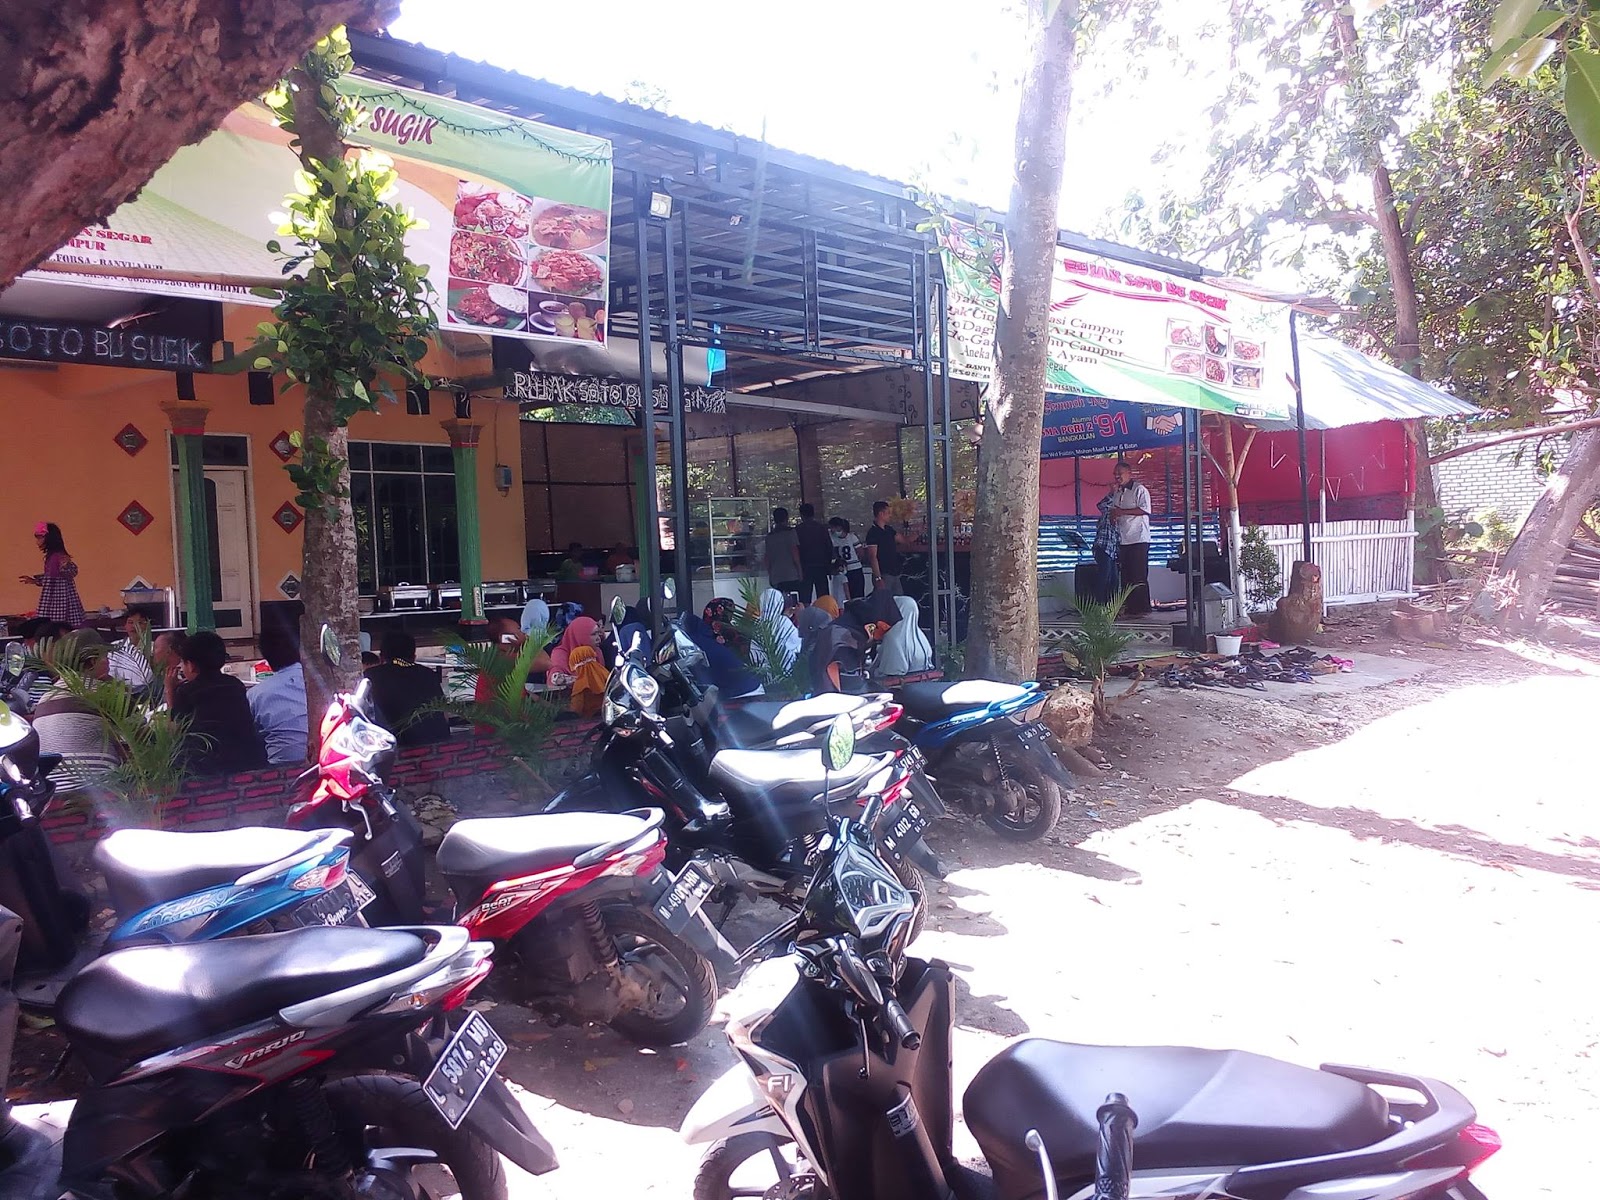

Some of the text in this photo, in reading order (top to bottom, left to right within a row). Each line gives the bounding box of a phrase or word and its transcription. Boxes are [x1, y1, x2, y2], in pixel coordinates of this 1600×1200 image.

[67, 238, 107, 251] MPUR
[96, 230, 153, 245] SEGAR
[962, 320, 995, 336] Dagi
[1070, 318, 1124, 337] Campur
[0, 324, 84, 356] OTO
[1069, 340, 1124, 358] Campur
[1057, 350, 1098, 365] Ayam
[1060, 423, 1085, 435] PGRI
[1086, 421, 1094, 432] 2
[1057, 432, 1096, 443] BANGKALAN
[884, 836, 897, 851] M
[894, 817, 912, 838] 4012
[658, 906, 672, 920] M
[767, 1076, 790, 1093] FI
[428, 1084, 447, 1105] L
